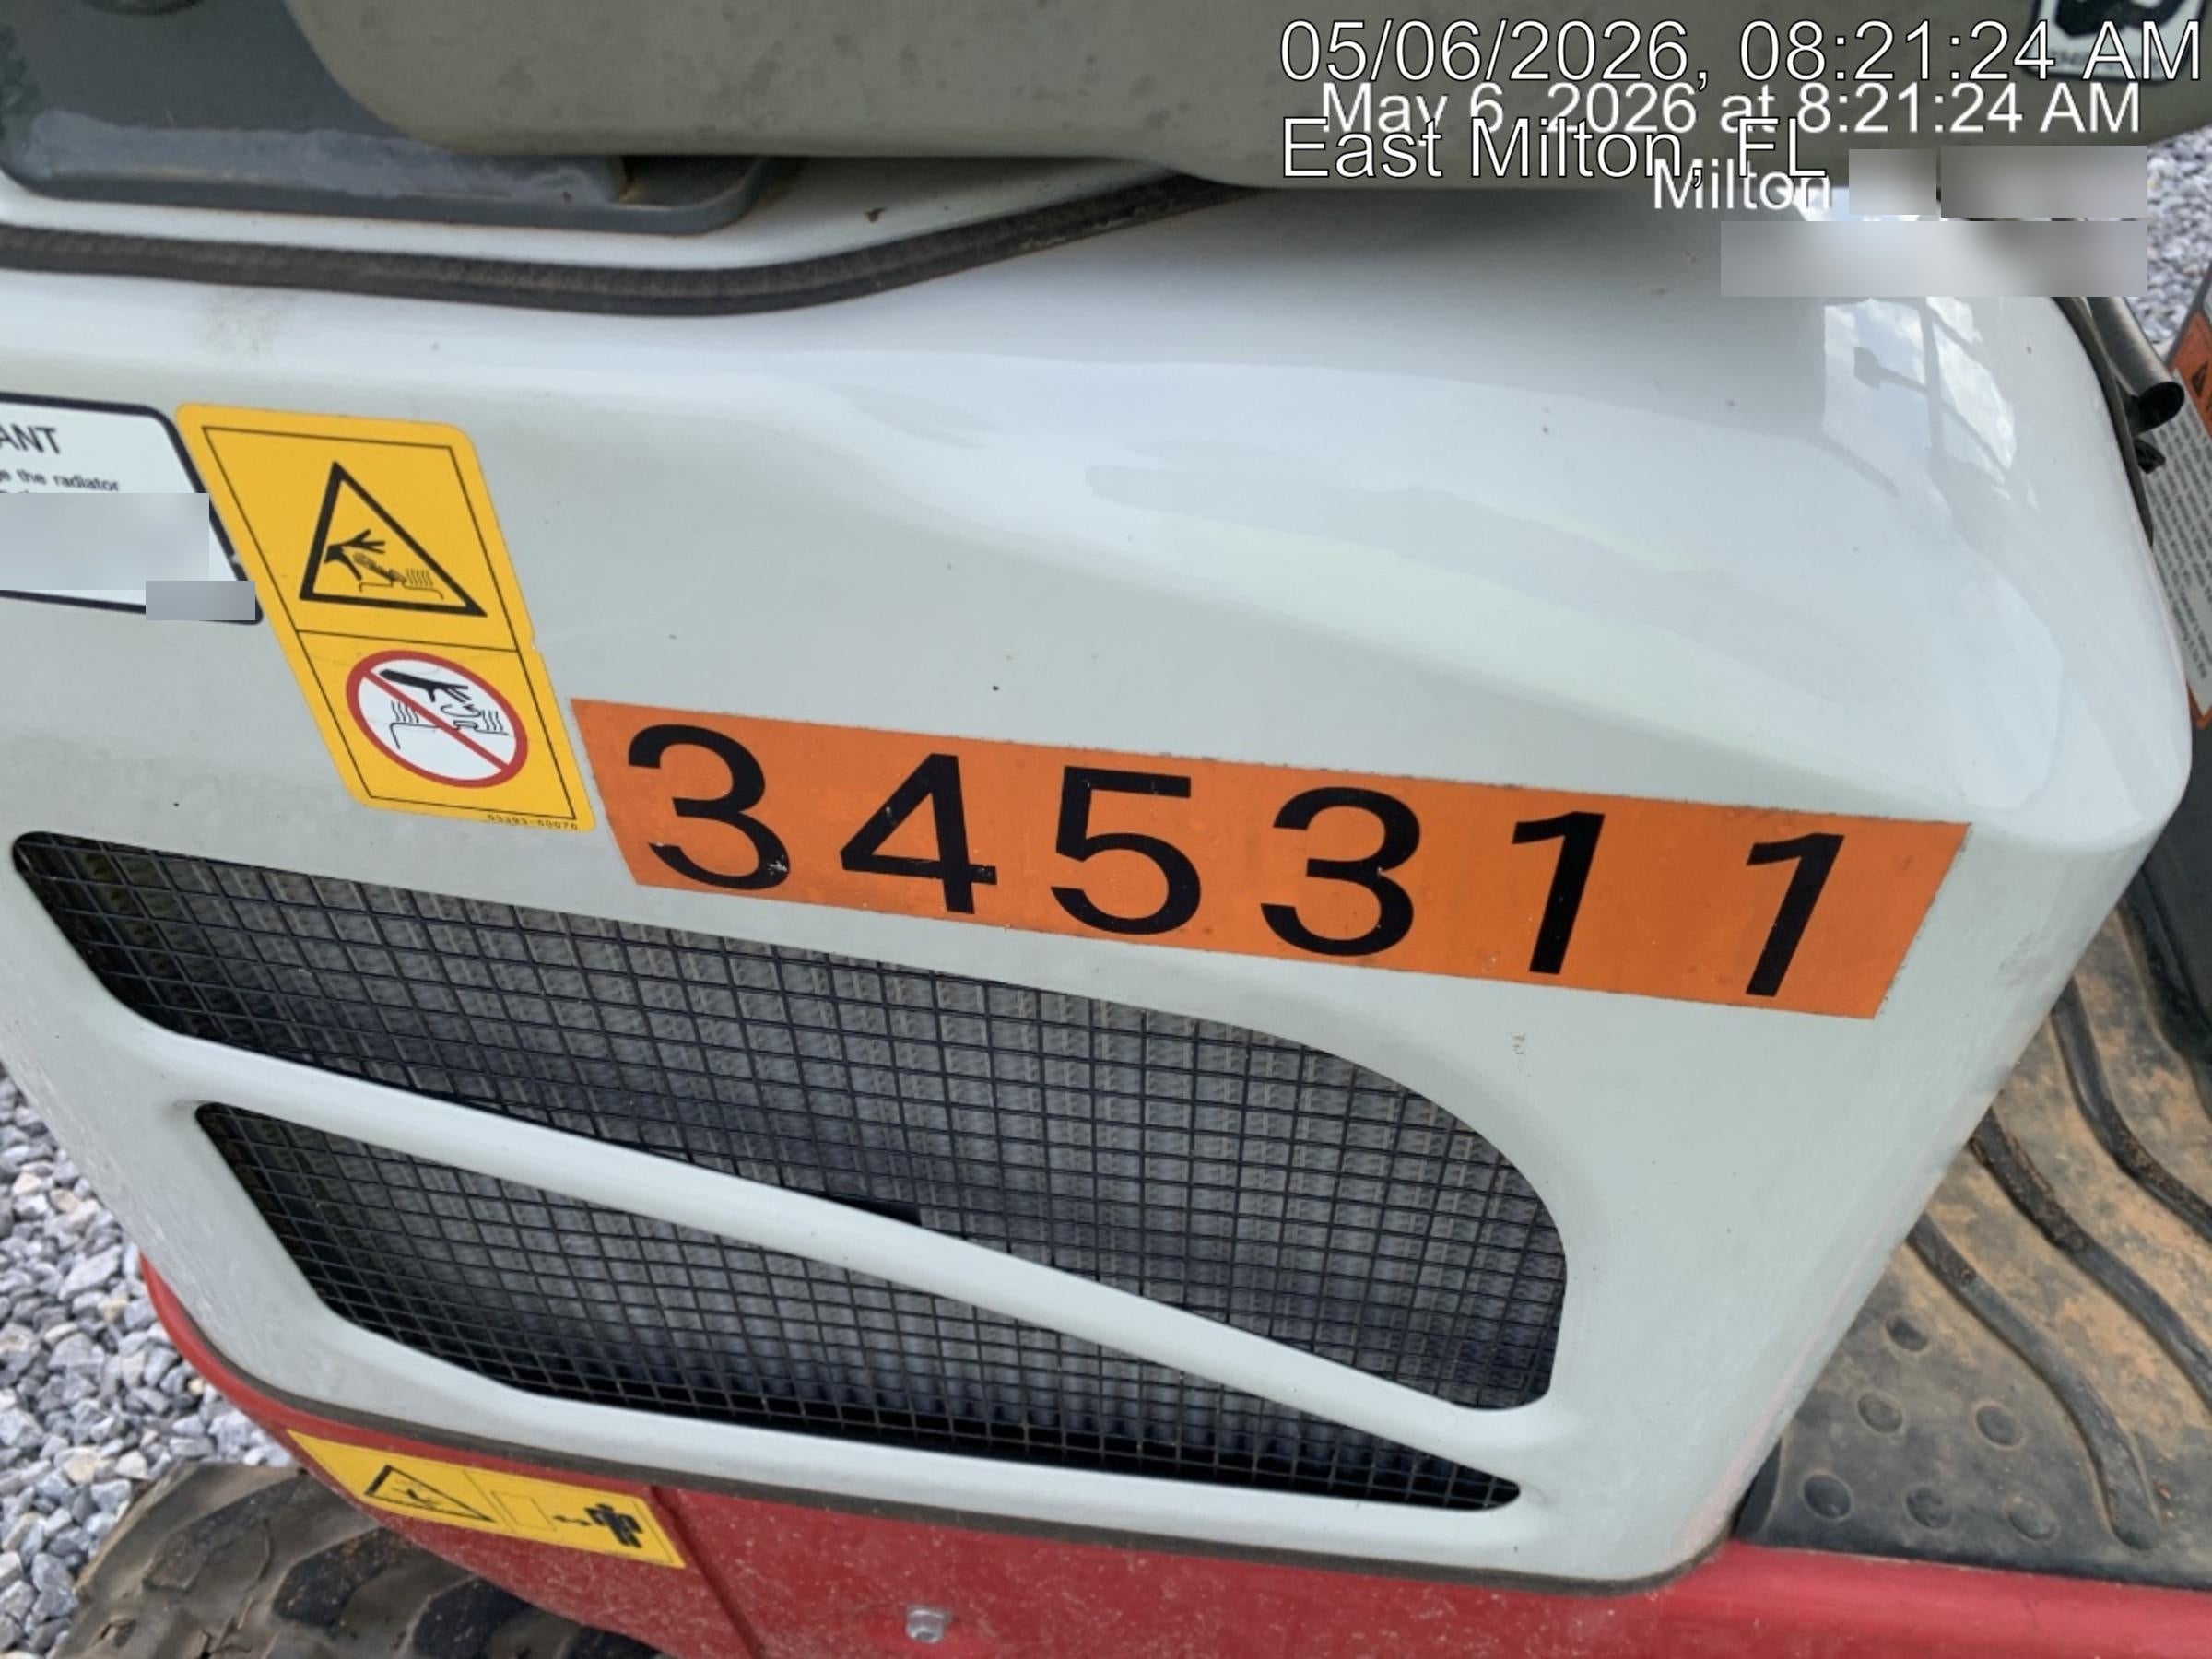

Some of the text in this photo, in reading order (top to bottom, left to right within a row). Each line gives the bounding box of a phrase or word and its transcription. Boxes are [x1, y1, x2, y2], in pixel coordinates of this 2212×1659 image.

[16, 469, 47, 485] the
[53, 475, 120, 491] radiator
[629, 724, 1844, 997] 345311
